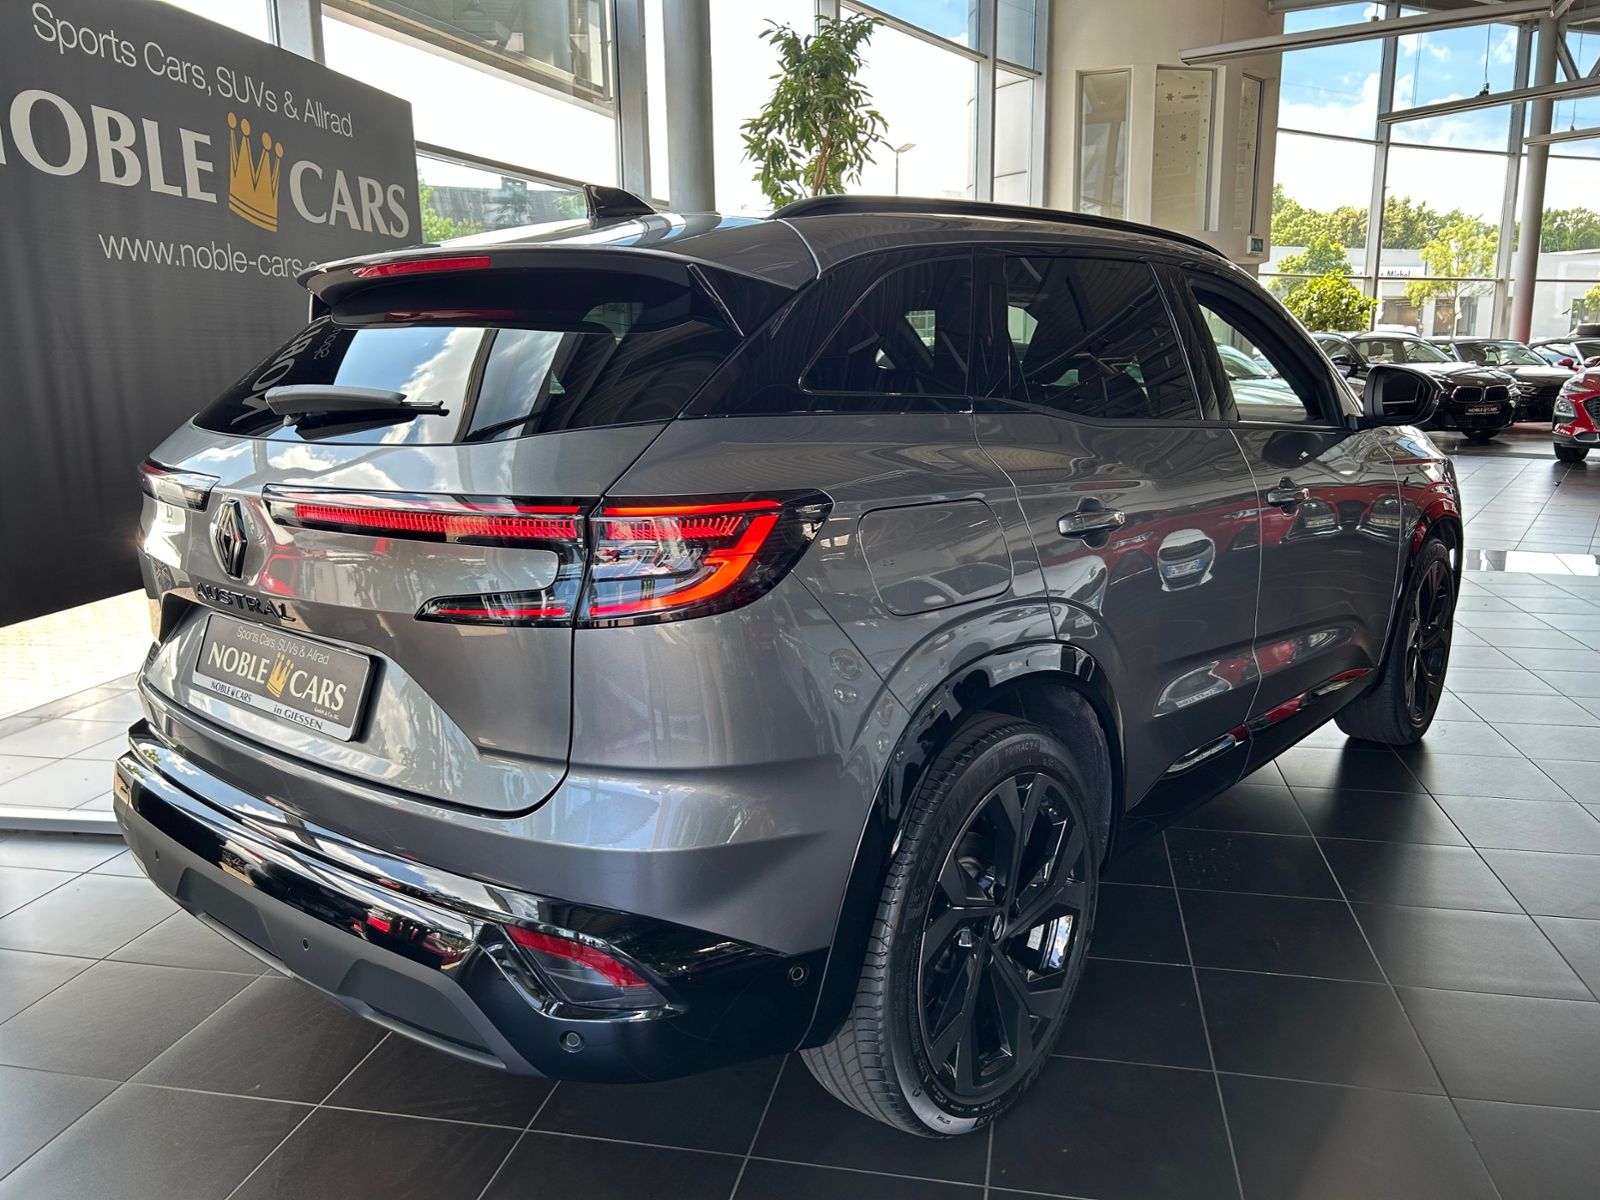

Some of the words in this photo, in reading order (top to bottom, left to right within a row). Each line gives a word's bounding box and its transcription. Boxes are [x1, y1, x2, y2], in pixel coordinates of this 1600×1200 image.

[32, 2, 137, 67] Sports
[144, 42, 212, 96] Cars,
[216, 66, 277, 113] SUVs
[284, 91, 300, 121] &
[304, 98, 354, 138] Allrad
[0, 89, 218, 204] OBLE
[289, 160, 410, 238] CARS
[197, 582, 296, 622] AUSTRAL
[236, 626, 259, 643] Sports
[277, 638, 298, 657] SUVs
[299, 645, 306, 657] &
[207, 641, 270, 685] NOBLE
[289, 669, 348, 712] CARS
[211, 681, 230, 695] NOBLE
[235, 689, 253, 703] CARS
[273, 704, 283, 714] in
[284, 707, 324, 730] GIESSEN
